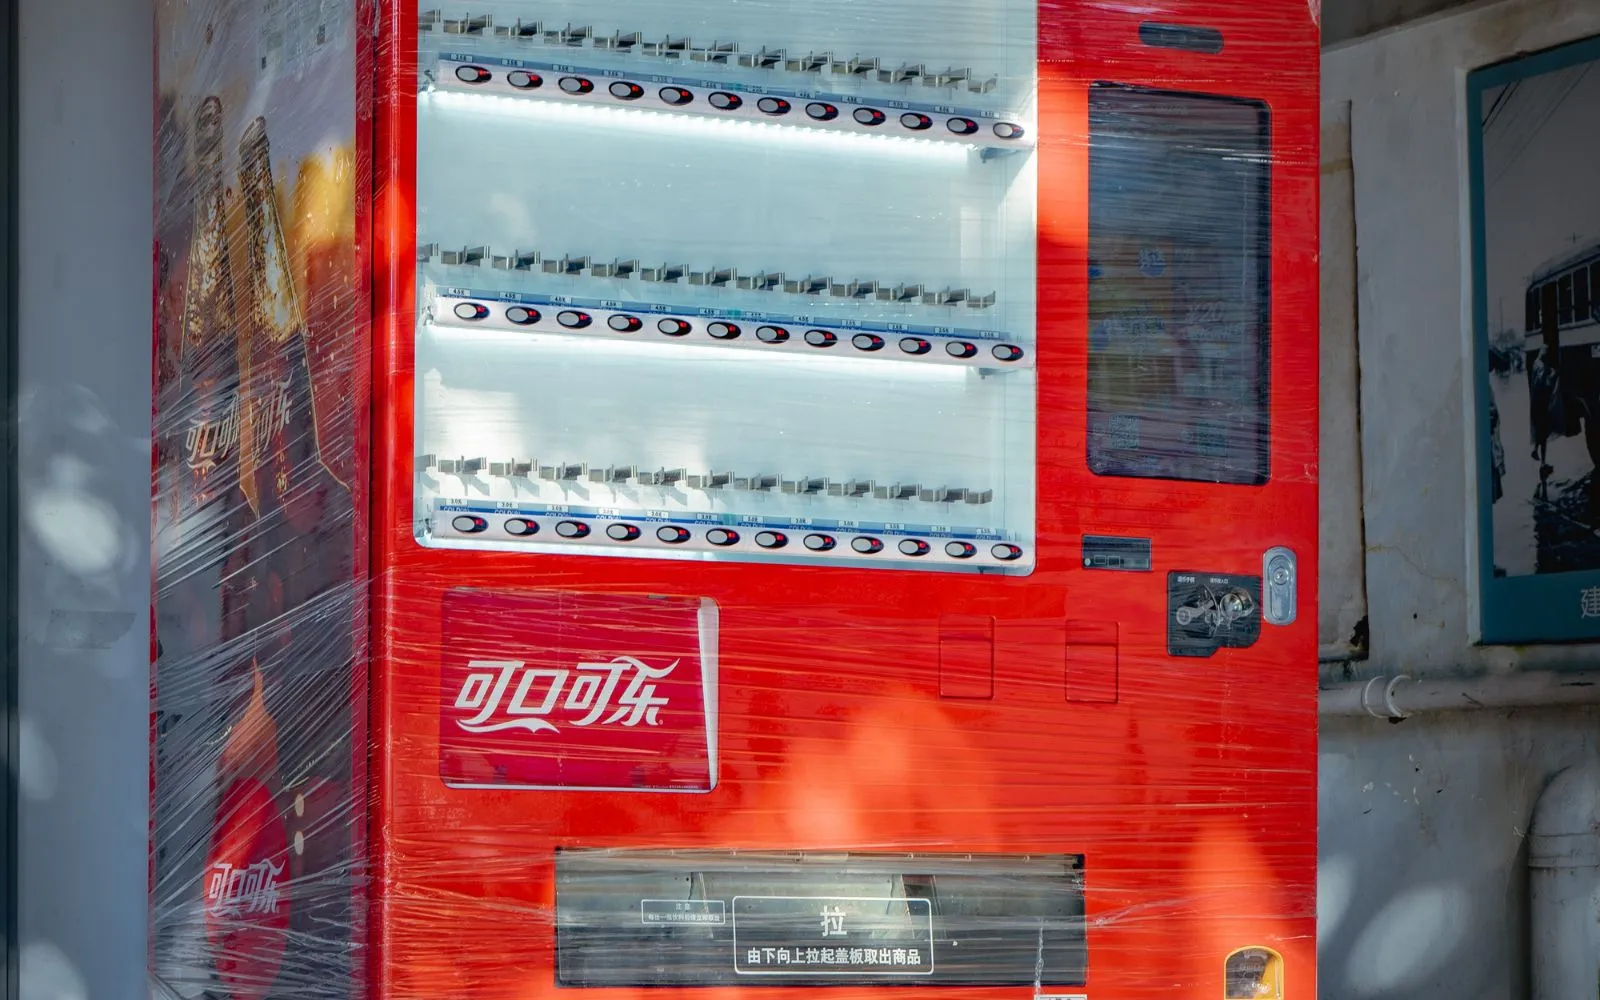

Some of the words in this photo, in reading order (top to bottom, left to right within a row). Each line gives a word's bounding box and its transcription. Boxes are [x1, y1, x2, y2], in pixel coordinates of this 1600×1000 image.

[455, 656, 681, 734] 可口可乐
[208, 858, 285, 917] 可口可乐
[819, 905, 848, 937] 拉
[747, 947, 921, 965] 由下向上拉起盖板取出商品
